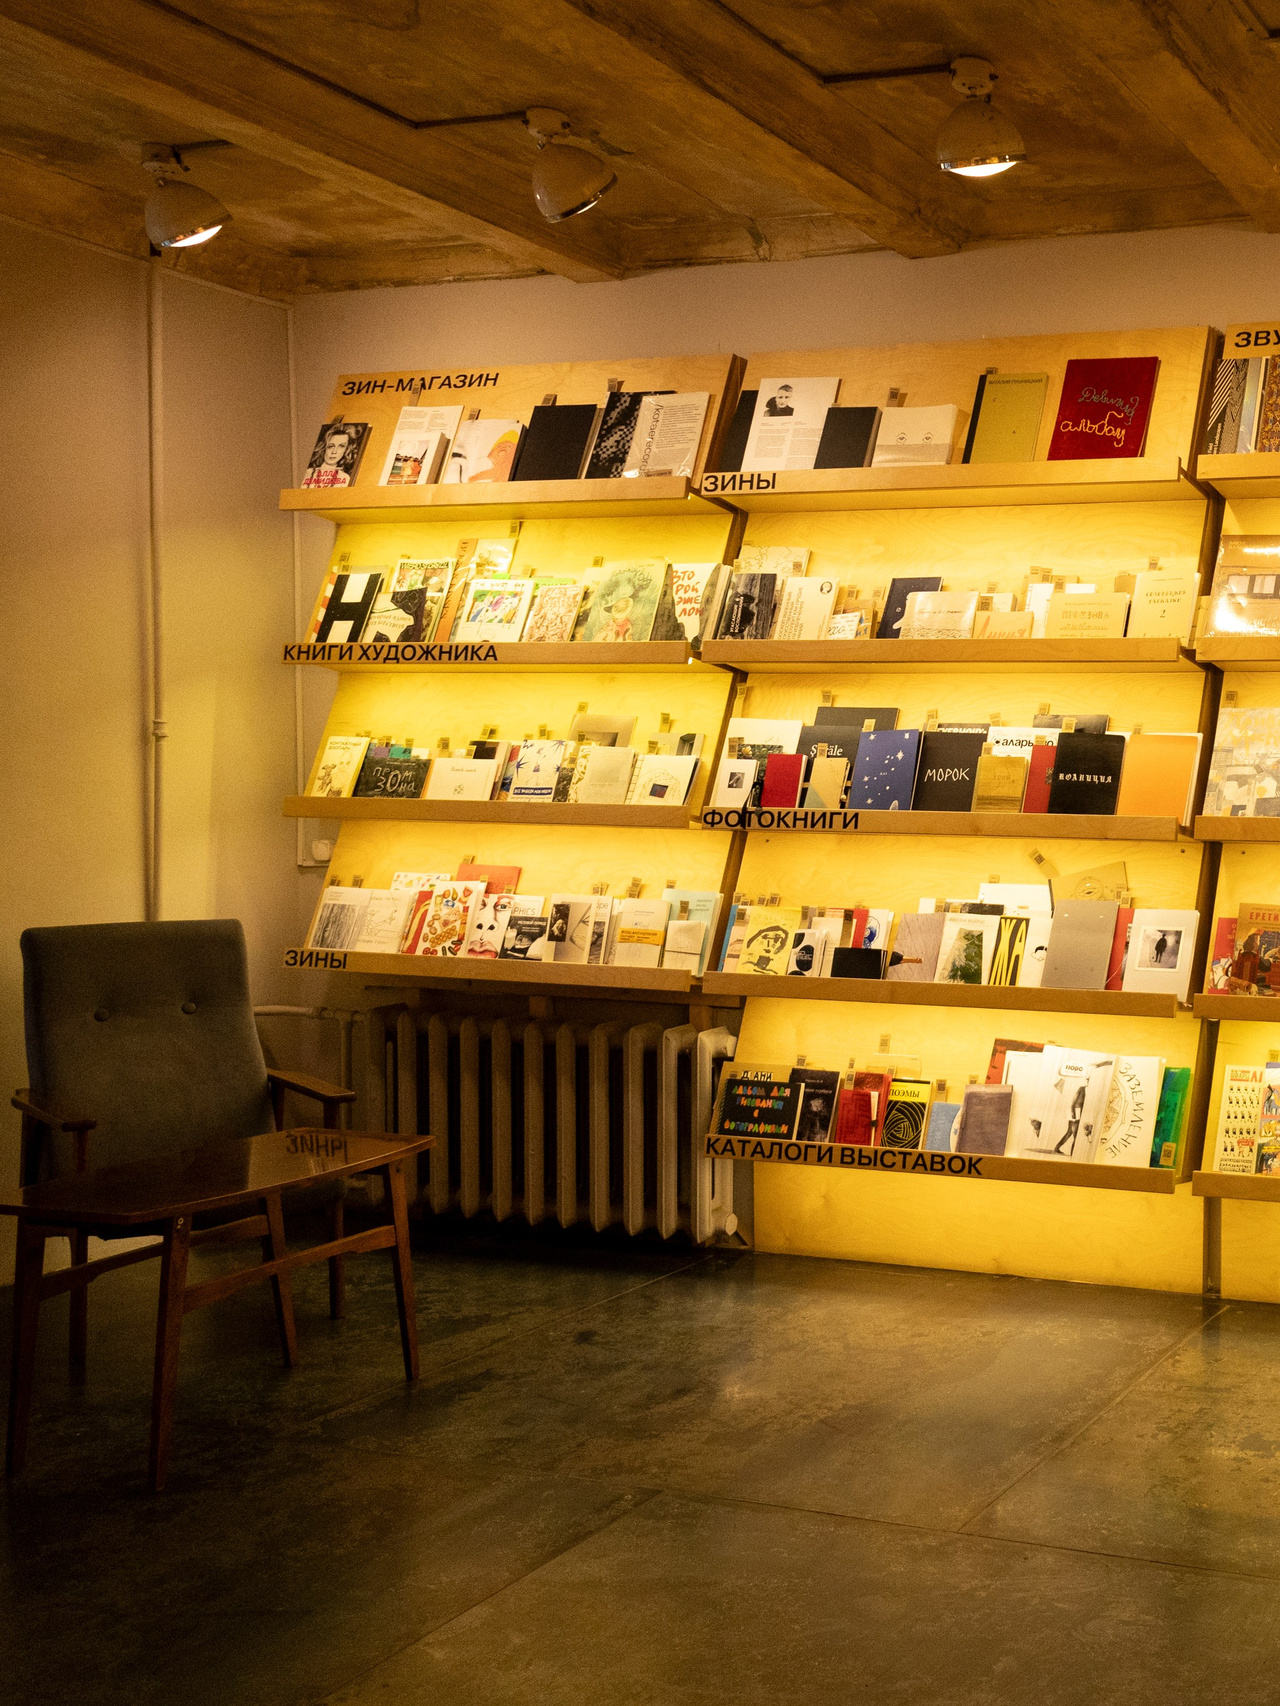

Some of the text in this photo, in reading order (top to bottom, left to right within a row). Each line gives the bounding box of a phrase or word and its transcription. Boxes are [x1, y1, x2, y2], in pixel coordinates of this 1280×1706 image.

[341, 373, 499, 395] ЗИН-МАГАЗИН
[1060, 411, 1125, 447] альбом
[703, 473, 776, 492] ЗИНЫ
[671, 569, 696, 585] ВТО
[674, 581, 701, 594] РОЙ
[675, 594, 701, 605] ЭШЕ
[283, 645, 498, 664] КНИГИ ХУДОЖНИКА
[924, 767, 970, 784] МОРОК
[703, 809, 859, 830] ФОТОКНИГИ
[511, 906, 537, 916] PHICS
[284, 950, 348, 969] ЗИНЫ
[888, 1087, 920, 1099] ПОЭМЫ
[1105, 1062, 1145, 1159] ЗАЗЕМЛЕНИЕ
[706, 1137, 983, 1176] КАТАЛОГИ ВЫСТАВОК
